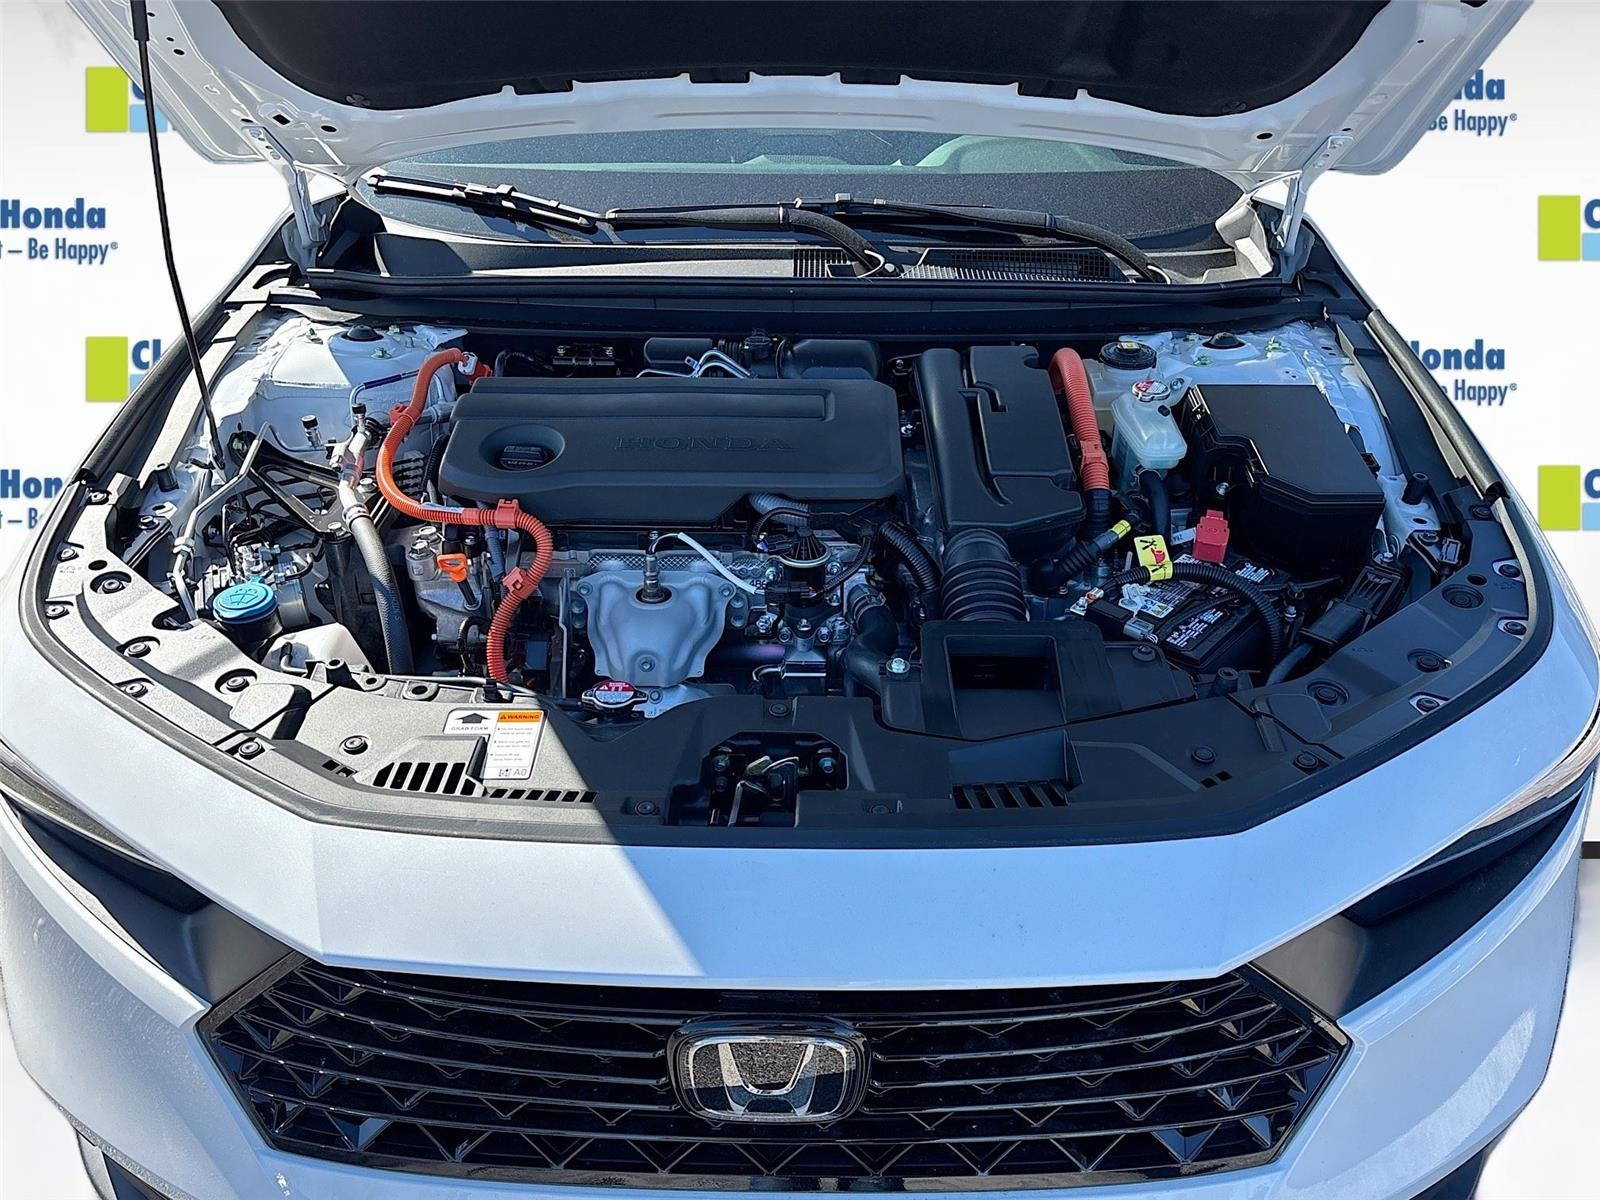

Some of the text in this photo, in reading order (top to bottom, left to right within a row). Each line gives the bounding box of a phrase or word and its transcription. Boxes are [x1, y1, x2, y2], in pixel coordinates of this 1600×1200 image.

[0, 197, 106, 229] Honda
[28, 237, 49, 260] Be
[132, 338, 161, 371] Cl
[615, 435, 795, 450] HONDA
[0, 468, 63, 499] Hon
